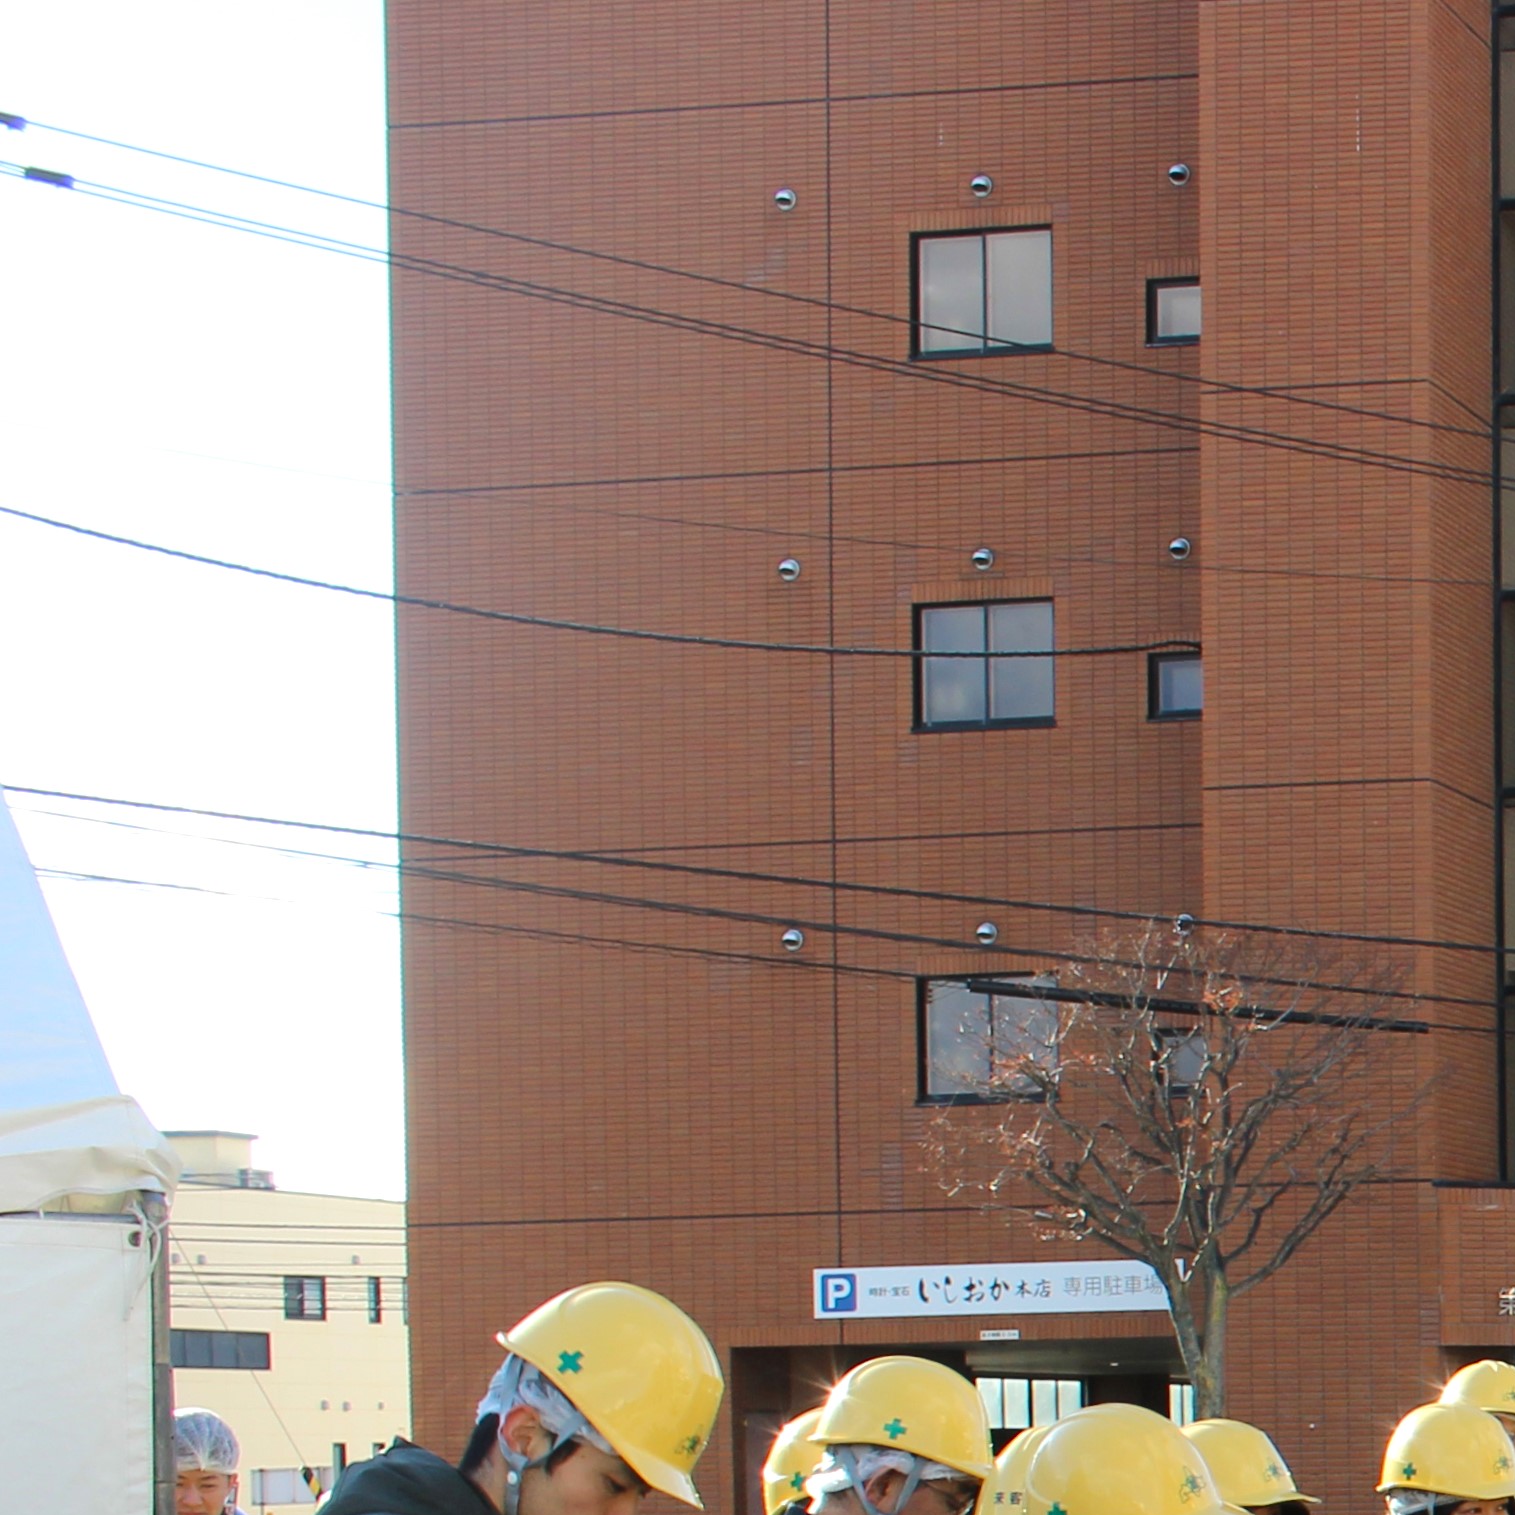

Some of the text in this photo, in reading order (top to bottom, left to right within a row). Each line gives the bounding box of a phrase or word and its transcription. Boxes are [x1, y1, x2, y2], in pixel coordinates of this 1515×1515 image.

[828, 1278, 852, 1309] P
[1063, 1274, 1163, 1297] 専用駐車場
